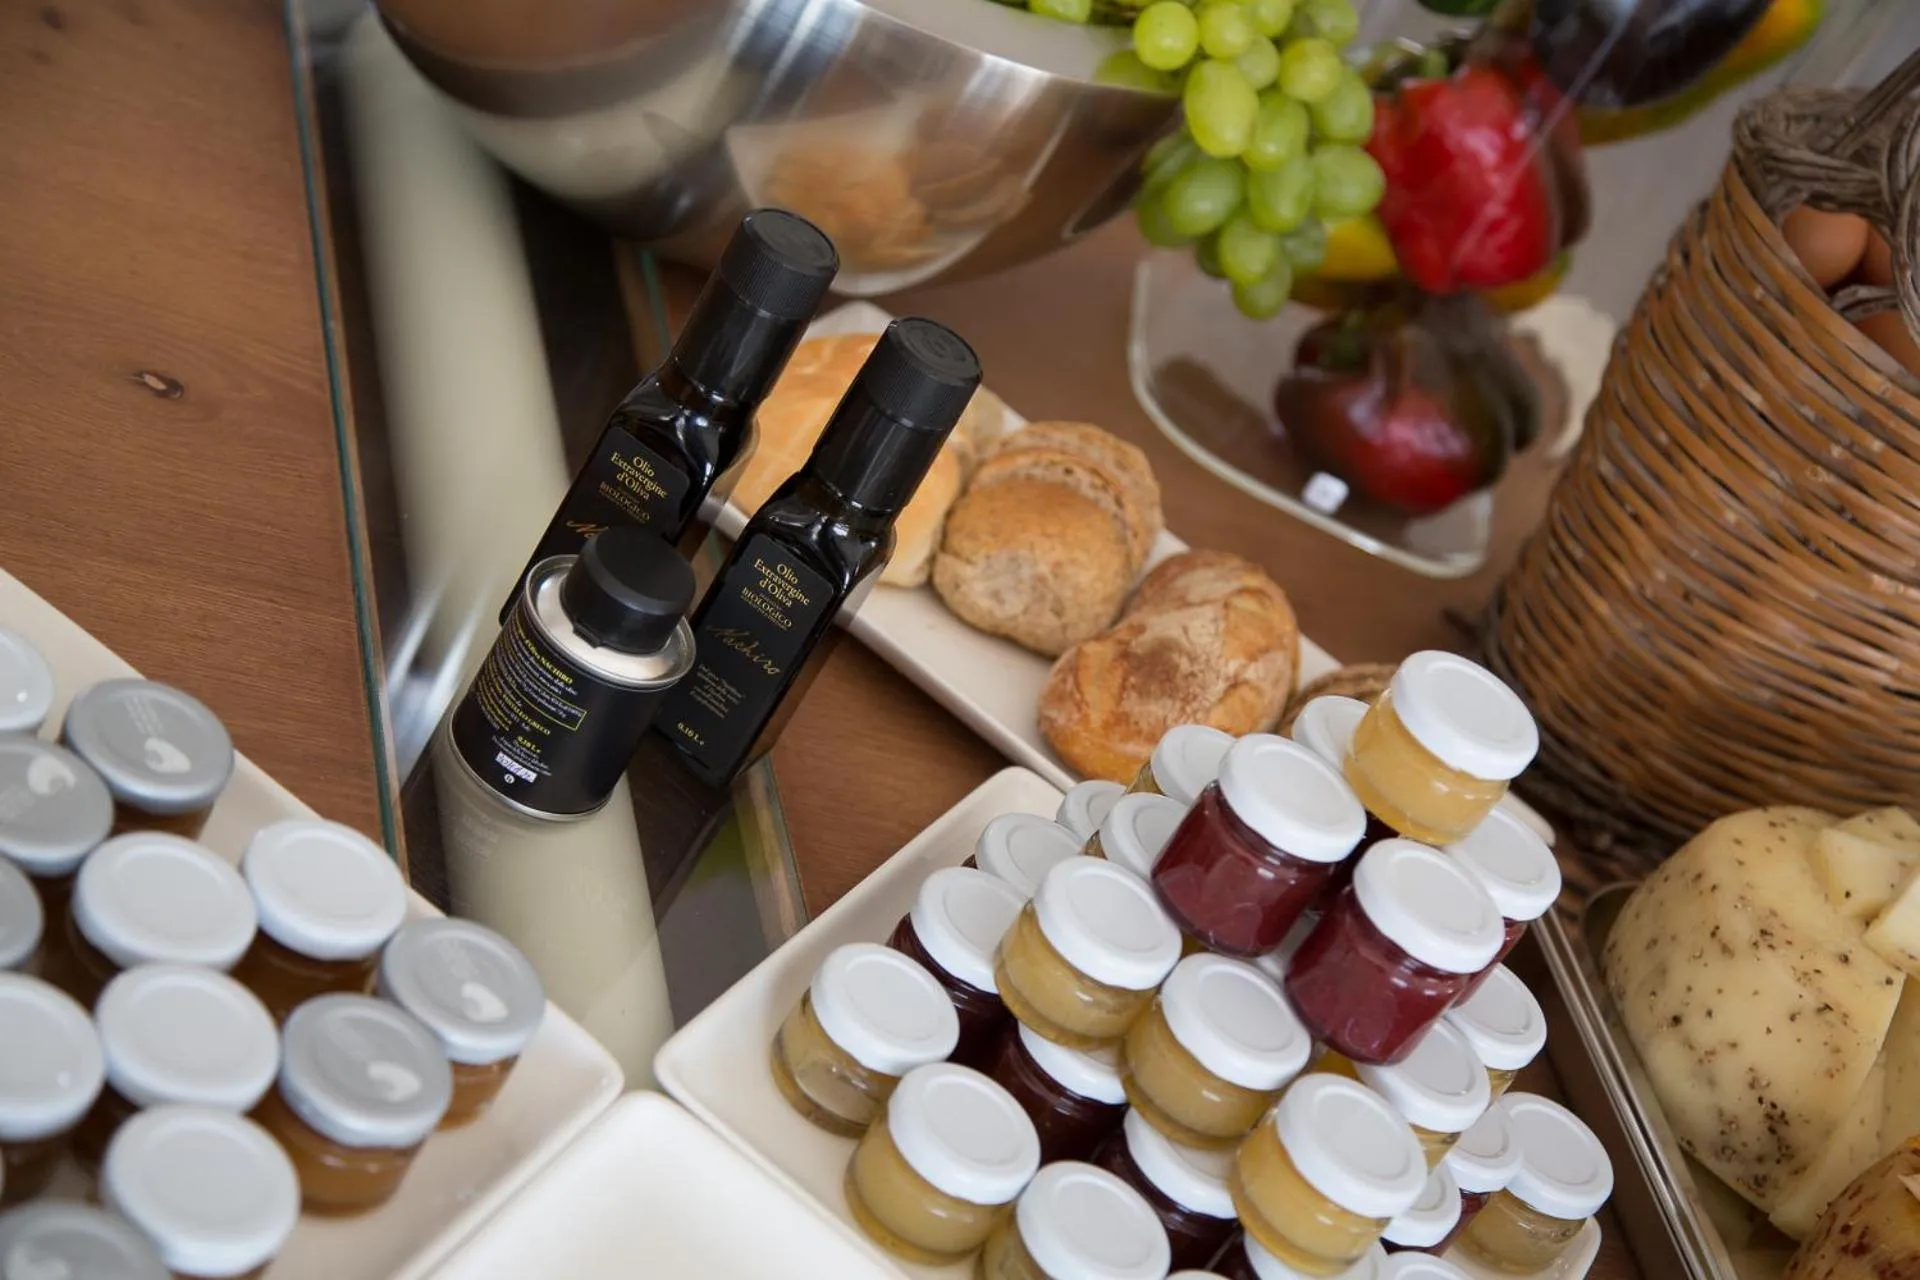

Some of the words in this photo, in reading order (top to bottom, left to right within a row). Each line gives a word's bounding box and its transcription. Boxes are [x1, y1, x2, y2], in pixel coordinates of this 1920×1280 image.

[610, 452, 668, 499] Extravergine
[632, 456, 656, 477] Olio
[599, 481, 651, 521] BIOLOGICO
[617, 472, 650, 500] d'Oliva
[754, 558, 810, 606] Extravergine
[776, 563, 799, 584] Olio
[742, 587, 792, 627] BIOLOGICO
[760, 578, 793, 607] d'Oliva
